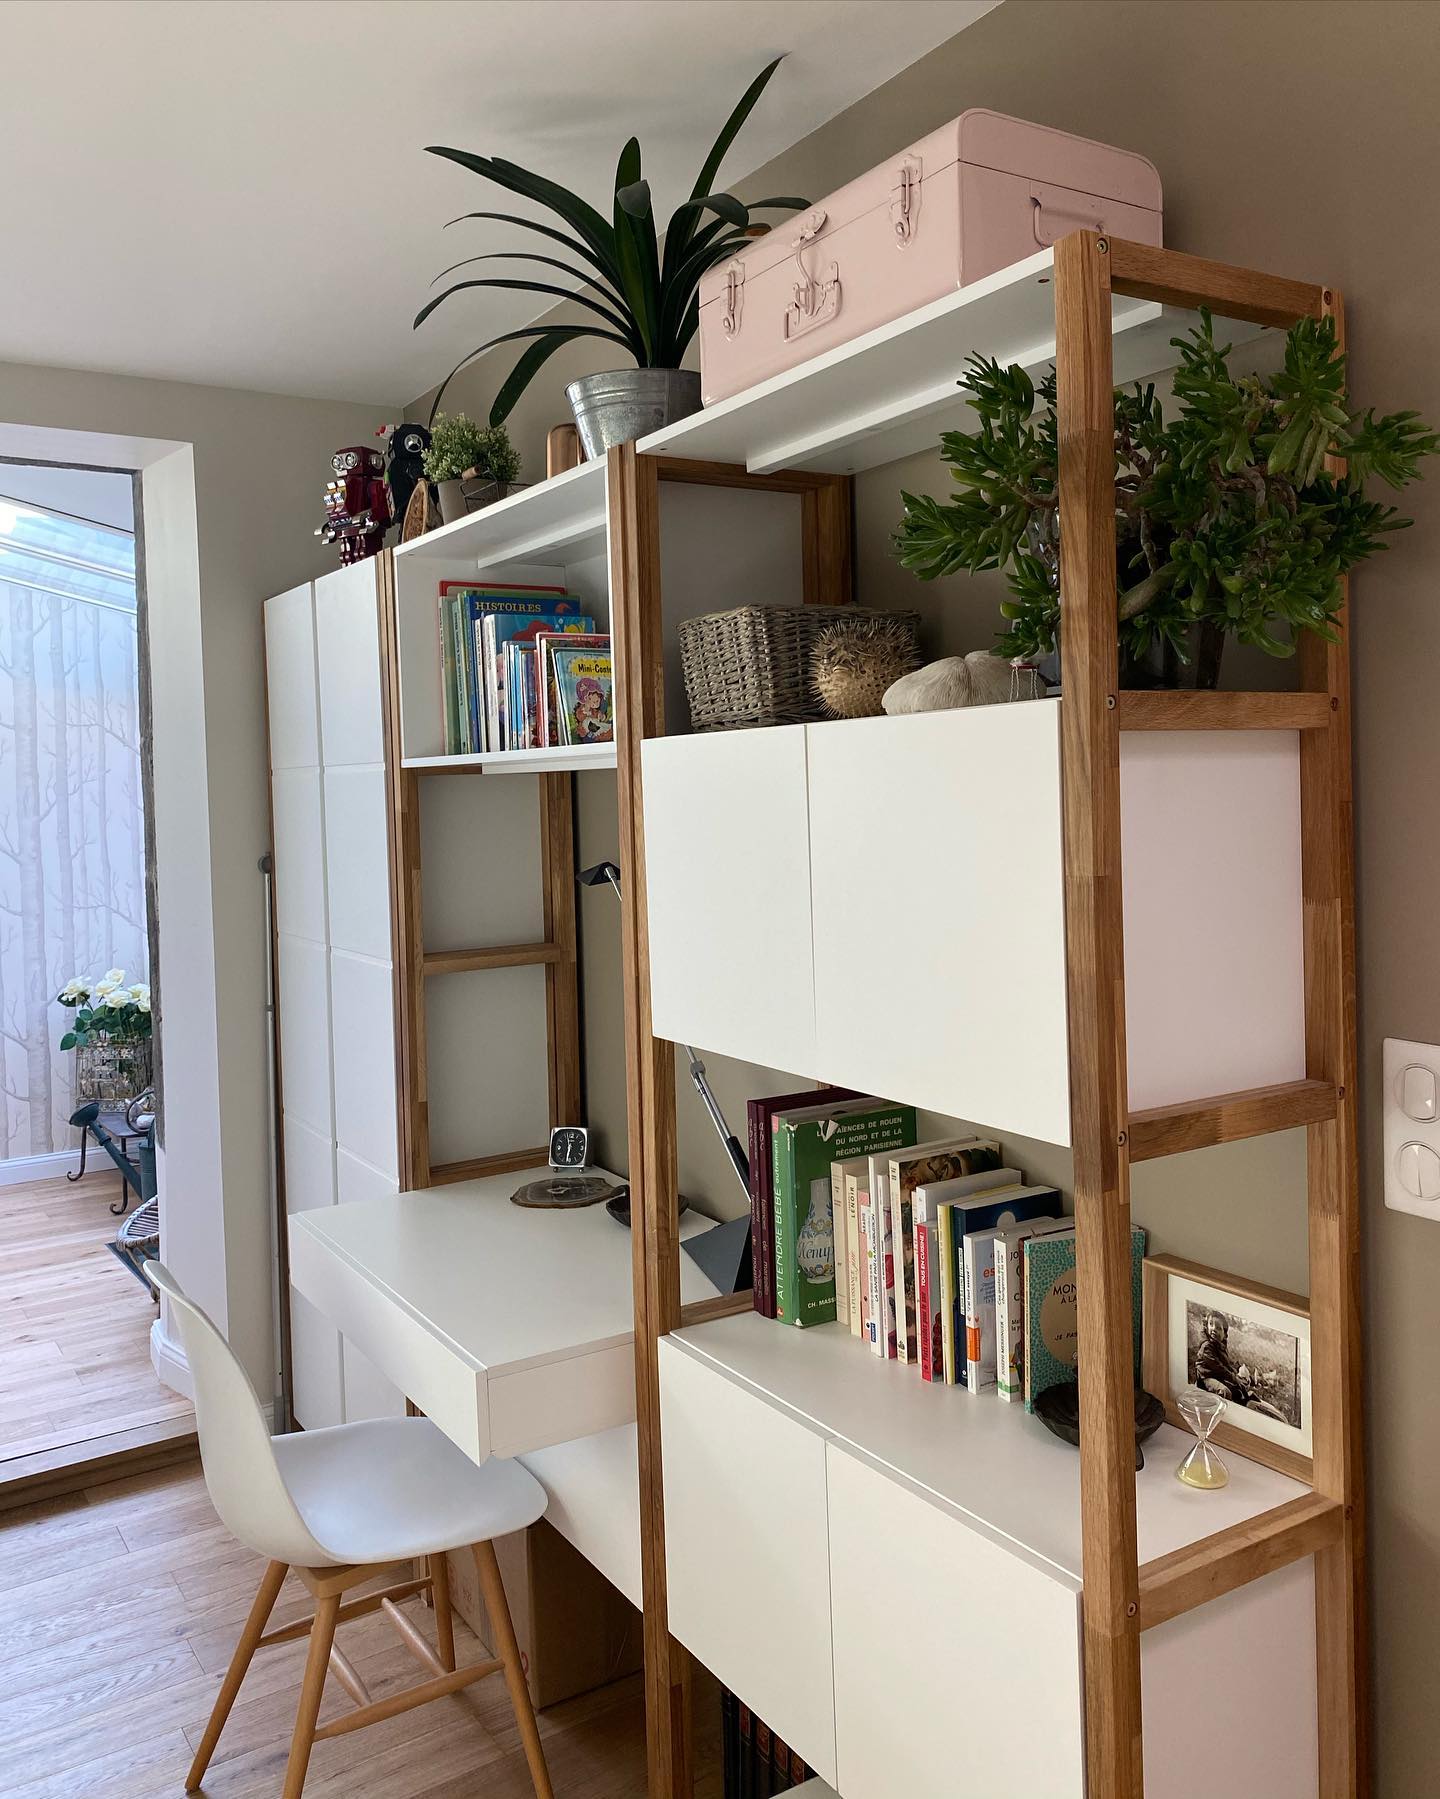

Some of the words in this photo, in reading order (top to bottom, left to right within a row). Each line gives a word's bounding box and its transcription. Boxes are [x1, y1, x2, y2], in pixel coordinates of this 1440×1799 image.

[475, 601, 541, 613] HISTOIRES
[836, 1123, 865, 1134] AÏENCES
[868, 1120, 877, 1128] DE
[879, 1116, 903, 1127] ROUEN
[835, 1138, 846, 1146] DU
[848, 1134, 868, 1143] NORD
[882, 1129, 891, 1137] DE
[893, 1127, 903, 1135] LA
[864, 1139, 903, 1152] PARISIENNE
[775, 1227, 784, 1301] ATTENDRE
[920, 1260, 925, 1270] EN
